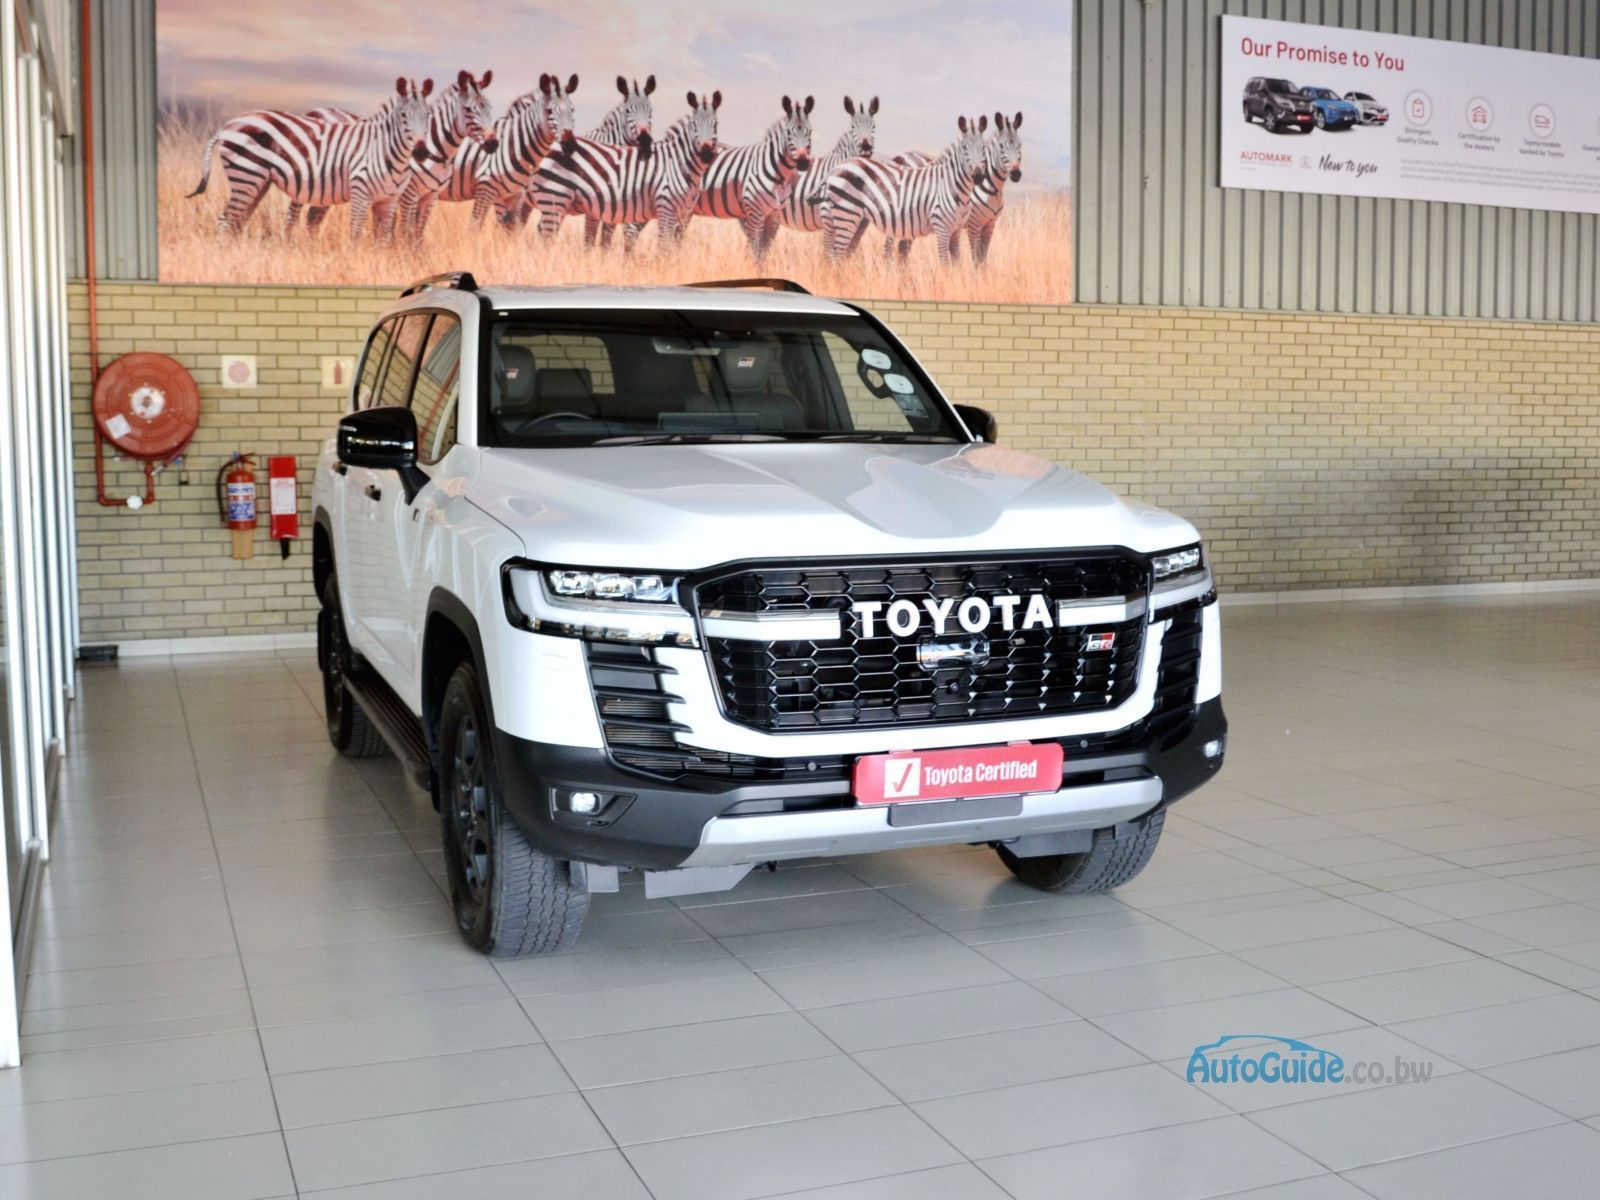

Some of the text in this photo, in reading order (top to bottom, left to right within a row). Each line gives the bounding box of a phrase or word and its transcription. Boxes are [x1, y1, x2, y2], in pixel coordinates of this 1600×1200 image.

[1241, 37, 1404, 71] Our Promise to You
[1240, 151, 1293, 163] AUTOMARK
[1318, 153, 1378, 178] New to you
[852, 594, 1054, 638] TOYOTA
[1087, 634, 1114, 651] GR
[924, 759, 1038, 787] Toyota Certified
